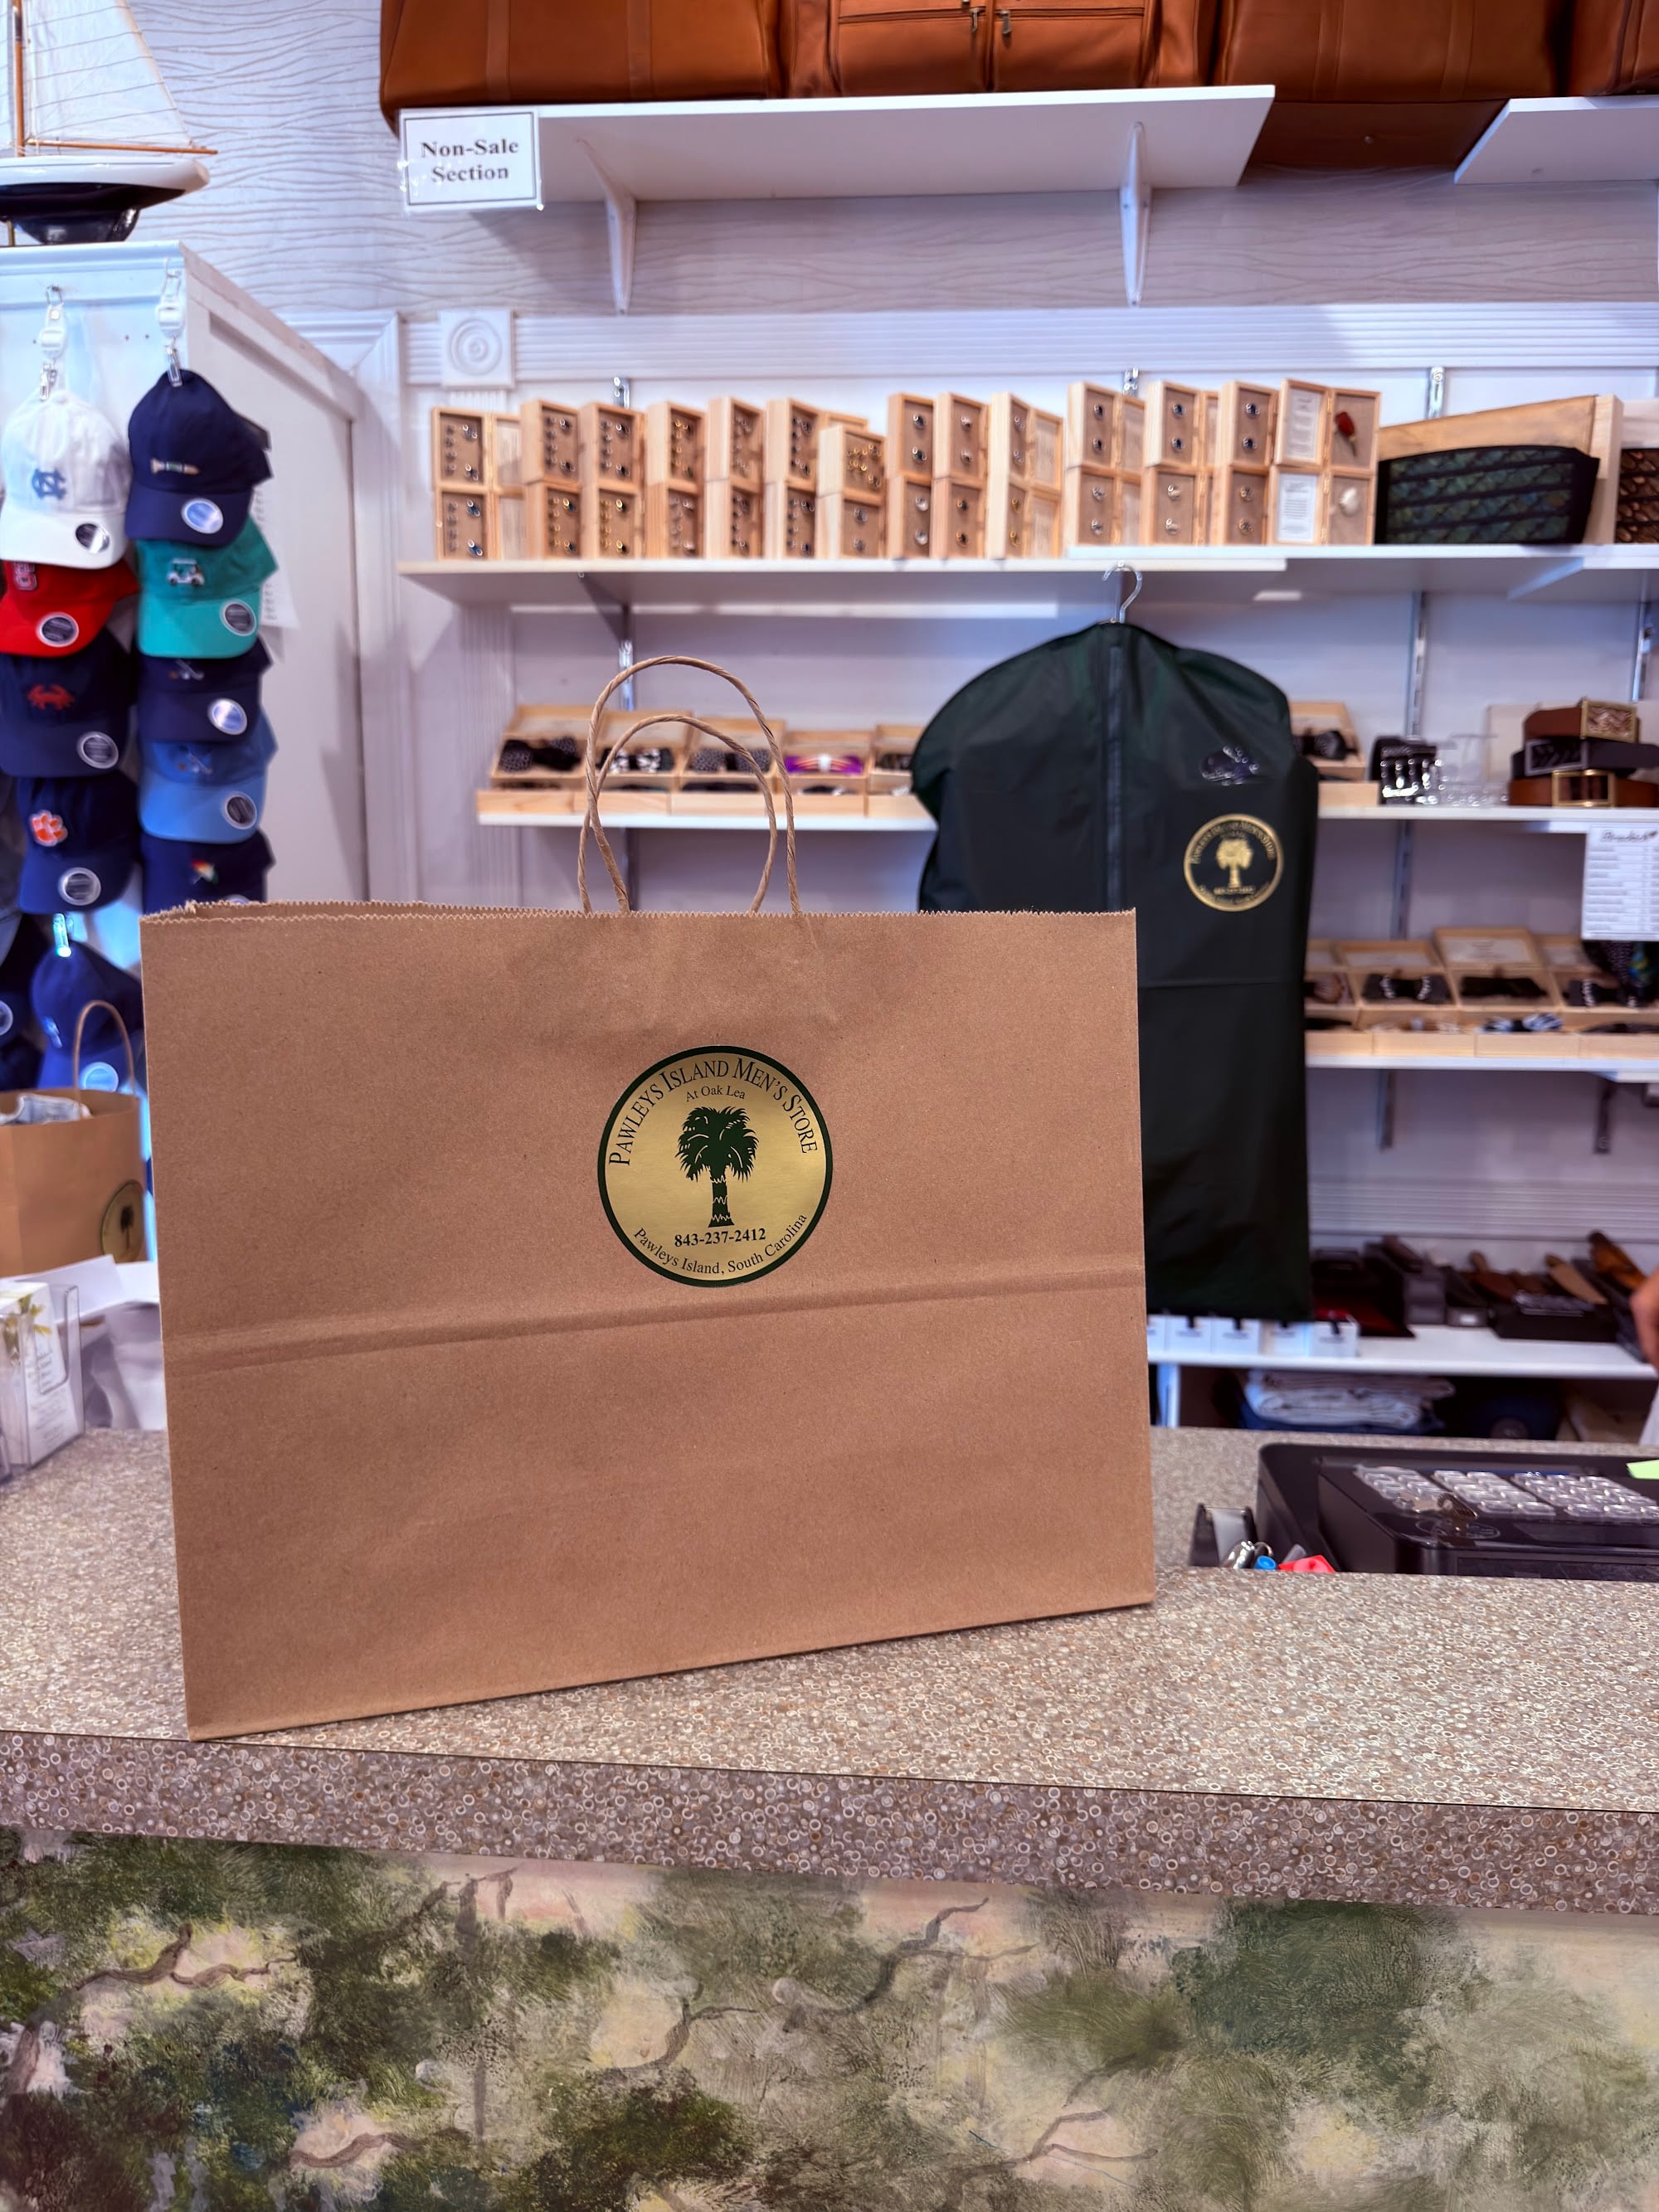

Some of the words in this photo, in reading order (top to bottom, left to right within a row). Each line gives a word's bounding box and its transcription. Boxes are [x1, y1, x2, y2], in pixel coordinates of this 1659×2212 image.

[421, 139, 520, 158] Non-Sale
[431, 164, 509, 183] Section
[686, 1089, 698, 1102] At
[701, 1085, 723, 1096] Oak
[726, 1085, 746, 1100] Lea
[608, 1082, 664, 1166] PAWLEYS
[659, 1060, 729, 1093] ISLAND
[732, 1057, 788, 1101] MEN'S
[782, 1093, 818, 1154] STORE
[633, 1227, 679, 1267] Pawleys
[681, 1257, 725, 1276] Island,
[727, 1252, 764, 1273] South
[764, 1213, 808, 1257] Carolina
[674, 1228, 766, 1247] 843-237-2412
